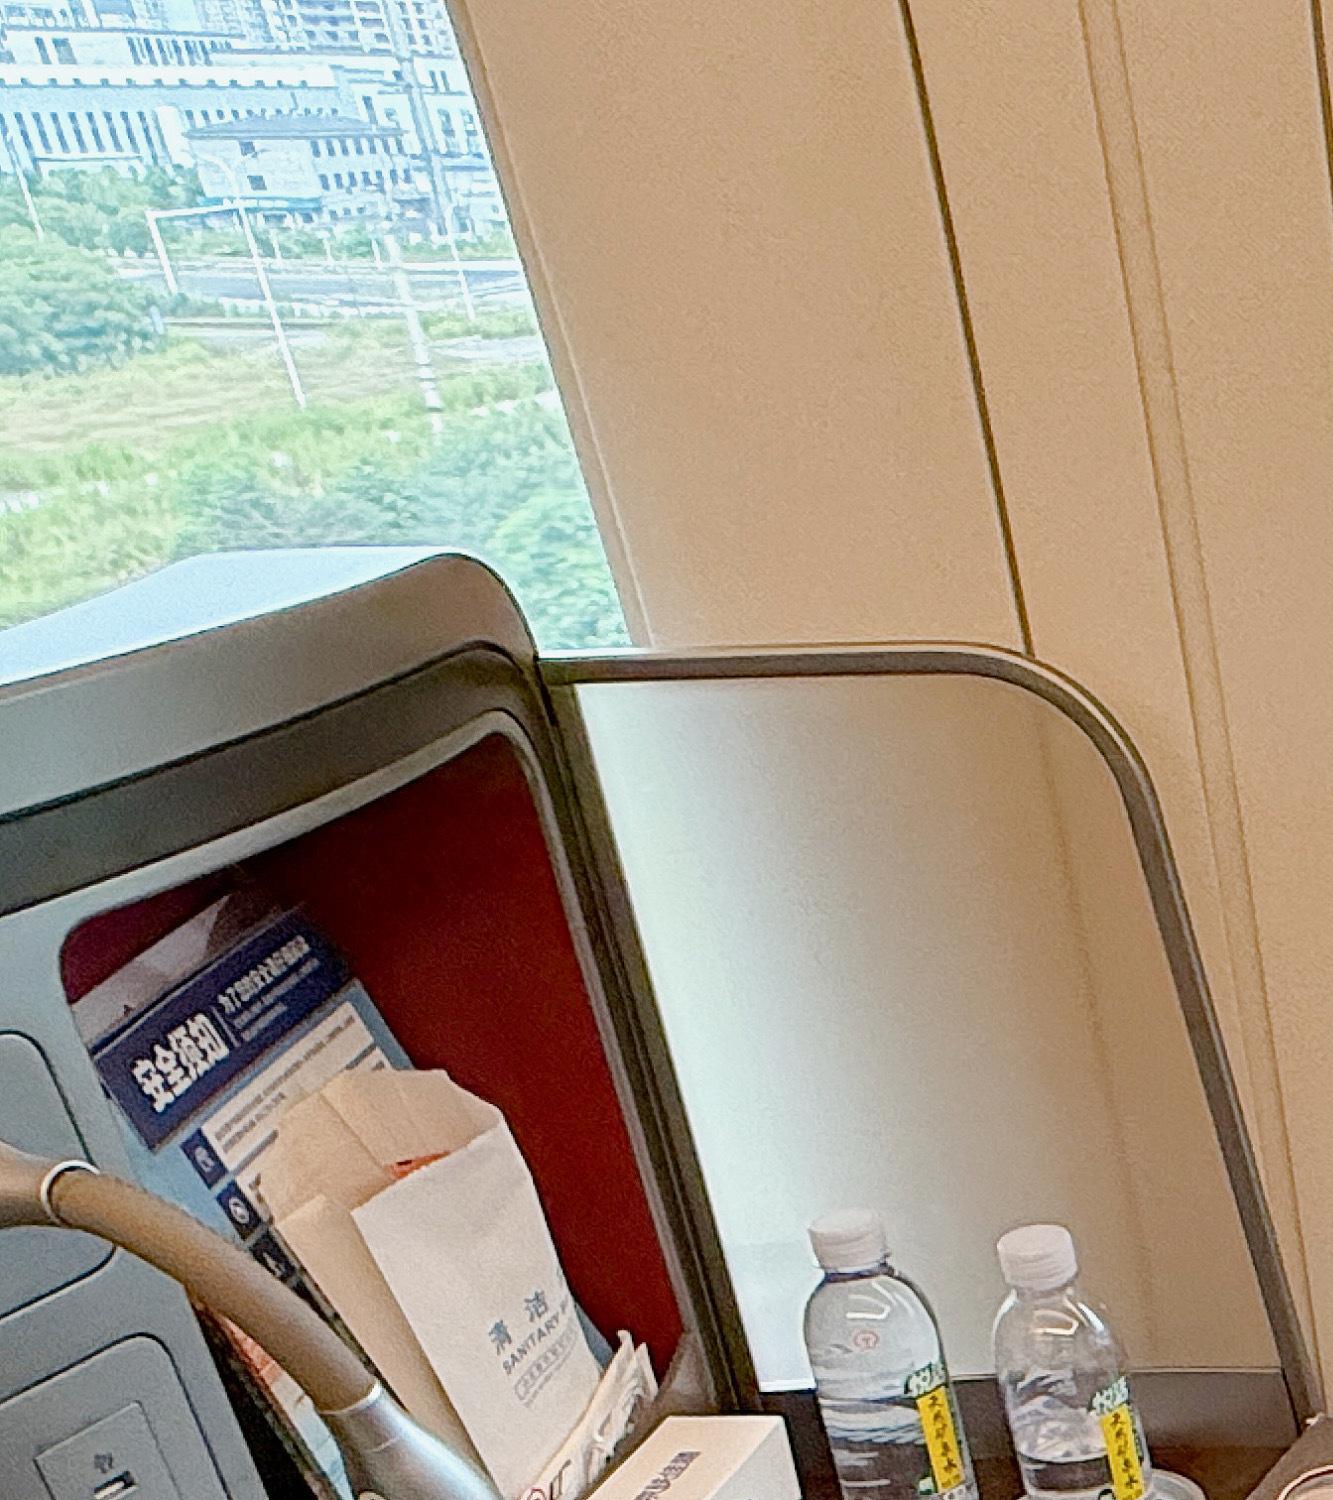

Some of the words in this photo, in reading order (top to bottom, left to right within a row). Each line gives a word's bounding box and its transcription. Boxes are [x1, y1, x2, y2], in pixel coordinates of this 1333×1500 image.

[131, 1013, 230, 1112] 安全须知
[503, 1311, 561, 1376] SANITARY
